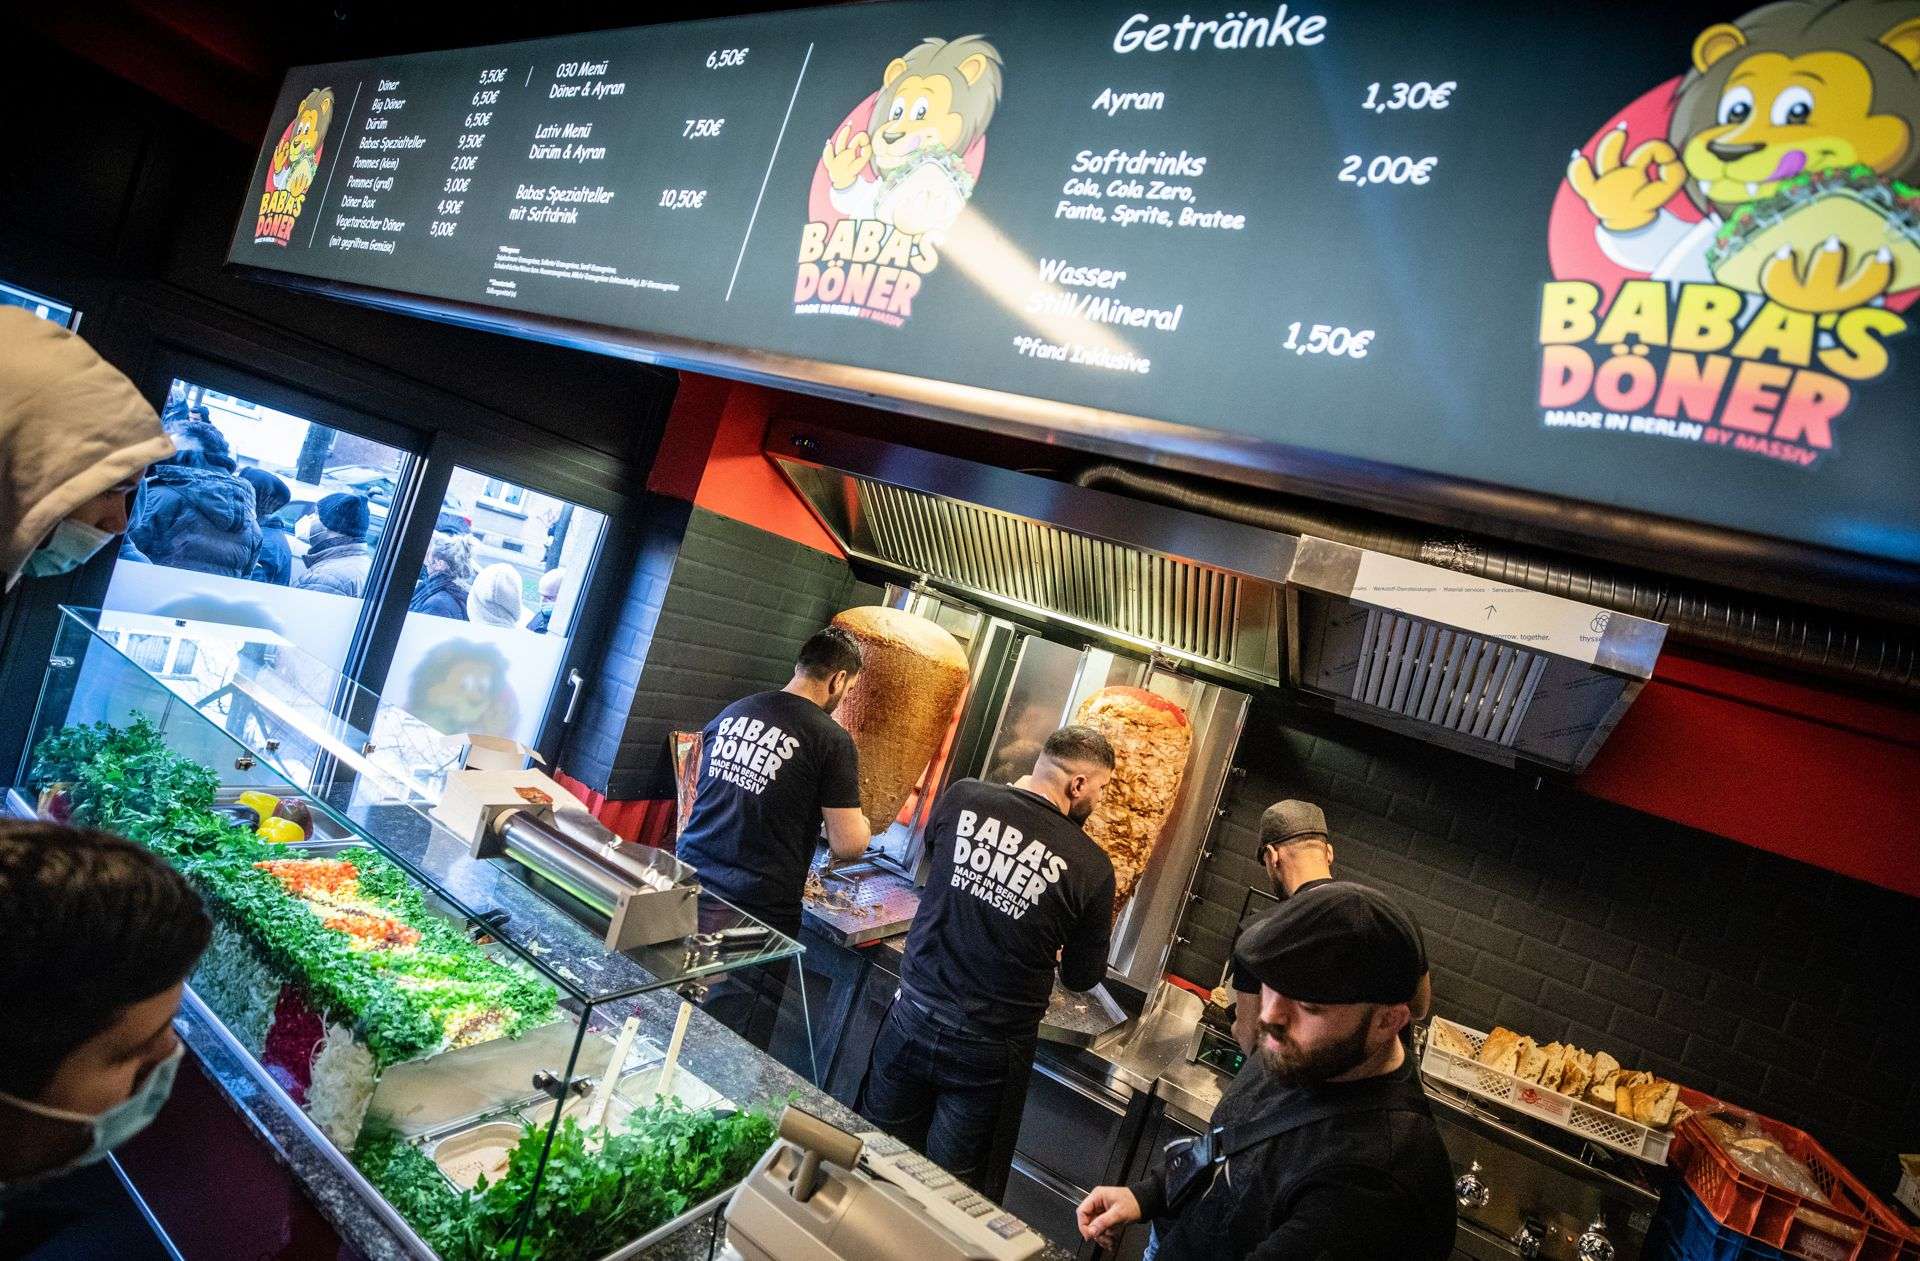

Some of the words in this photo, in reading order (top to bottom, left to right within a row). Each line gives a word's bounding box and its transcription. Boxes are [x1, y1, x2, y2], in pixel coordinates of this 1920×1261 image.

[1113, 4, 1329, 53] Getränke
[556, 63, 579, 78] 030
[577, 60, 609, 77] Menü
[706, 47, 749, 69] 6,50€
[378, 80, 400, 92] Döner
[479, 68, 508, 85] 5,50€
[549, 83, 582, 98] Döner
[581, 81, 592, 96] &
[591, 81, 626, 100] Ayran
[372, 98, 384, 113] Big
[383, 97, 406, 110] Döner
[472, 90, 500, 107] 6,50€
[1091, 88, 1166, 116] Ayran
[1361, 81, 1457, 114] 1,30€
[365, 117, 388, 130] Dürüm
[465, 112, 493, 128] 6,50€
[535, 123, 562, 139] Lativ
[561, 122, 593, 139] Menü
[683, 118, 725, 139] 7,50€
[359, 136, 380, 149] Babas
[380, 135, 426, 152] Spezialteller
[458, 134, 486, 150] 9,50€
[529, 144, 562, 159] Dürüm
[562, 143, 573, 159] &
[572, 144, 606, 164] Ayran
[352, 156, 380, 169] Pommes
[379, 157, 400, 171] (klein)
[451, 156, 479, 172] 2,00€
[1071, 149, 1207, 177] Softdrinks
[1338, 154, 1438, 187] 2,00€
[346, 175, 374, 188] Pommes
[444, 178, 472, 194] 3,00€
[516, 184, 547, 201] Babas
[546, 185, 615, 206] Spezialteller
[659, 189, 707, 211] 10,50€
[1063, 178, 1103, 199] Cola,
[1105, 179, 1145, 199] Cola
[1145, 181, 1196, 204] Zero,
[341, 194, 362, 208] Döner
[361, 195, 377, 209] Box
[437, 200, 464, 216] 4,90€
[509, 205, 528, 220] mit
[527, 205, 579, 224] Softdrink
[1054, 200, 1107, 223] Fanta,
[1111, 204, 1174, 228] Sprite,
[1177, 206, 1246, 231] Bratee
[254, 212, 296, 241] DÖNER
[336, 214, 383, 231] Vegetarischer
[382, 217, 406, 232] Döner
[430, 221, 457, 238] 5,00€
[798, 218, 945, 275] BABA'S
[793, 259, 922, 317] DÖNER
[1039, 258, 1127, 289] Wasser
[1283, 321, 1376, 360] 1,50€
[1539, 280, 1908, 381] BABA'S
[1538, 343, 1852, 450] DÖNER
[1544, 410, 1602, 429] MADE
[1604, 412, 1629, 431] IN
[1630, 416, 1703, 441] BERLIN
[1703, 427, 1734, 445] BY
[718, 716, 800, 760] BABA'S
[710, 735, 783, 781] DÖNER
[710, 758, 731, 770] MADE
[731, 763, 741, 773] IN
[740, 767, 768, 786] BERLIN
[708, 766, 722, 778] BY
[721, 769, 766, 795] MASSIV
[956, 809, 1068, 884] BABA'S
[953, 836, 1048, 906] DÖNER
[950, 874, 970, 891] BY
[970, 883, 1026, 920] MASSIV
[954, 865, 983, 883] MADE
[982, 876, 996, 890] IN
[995, 885, 1030, 911] BERLIN
